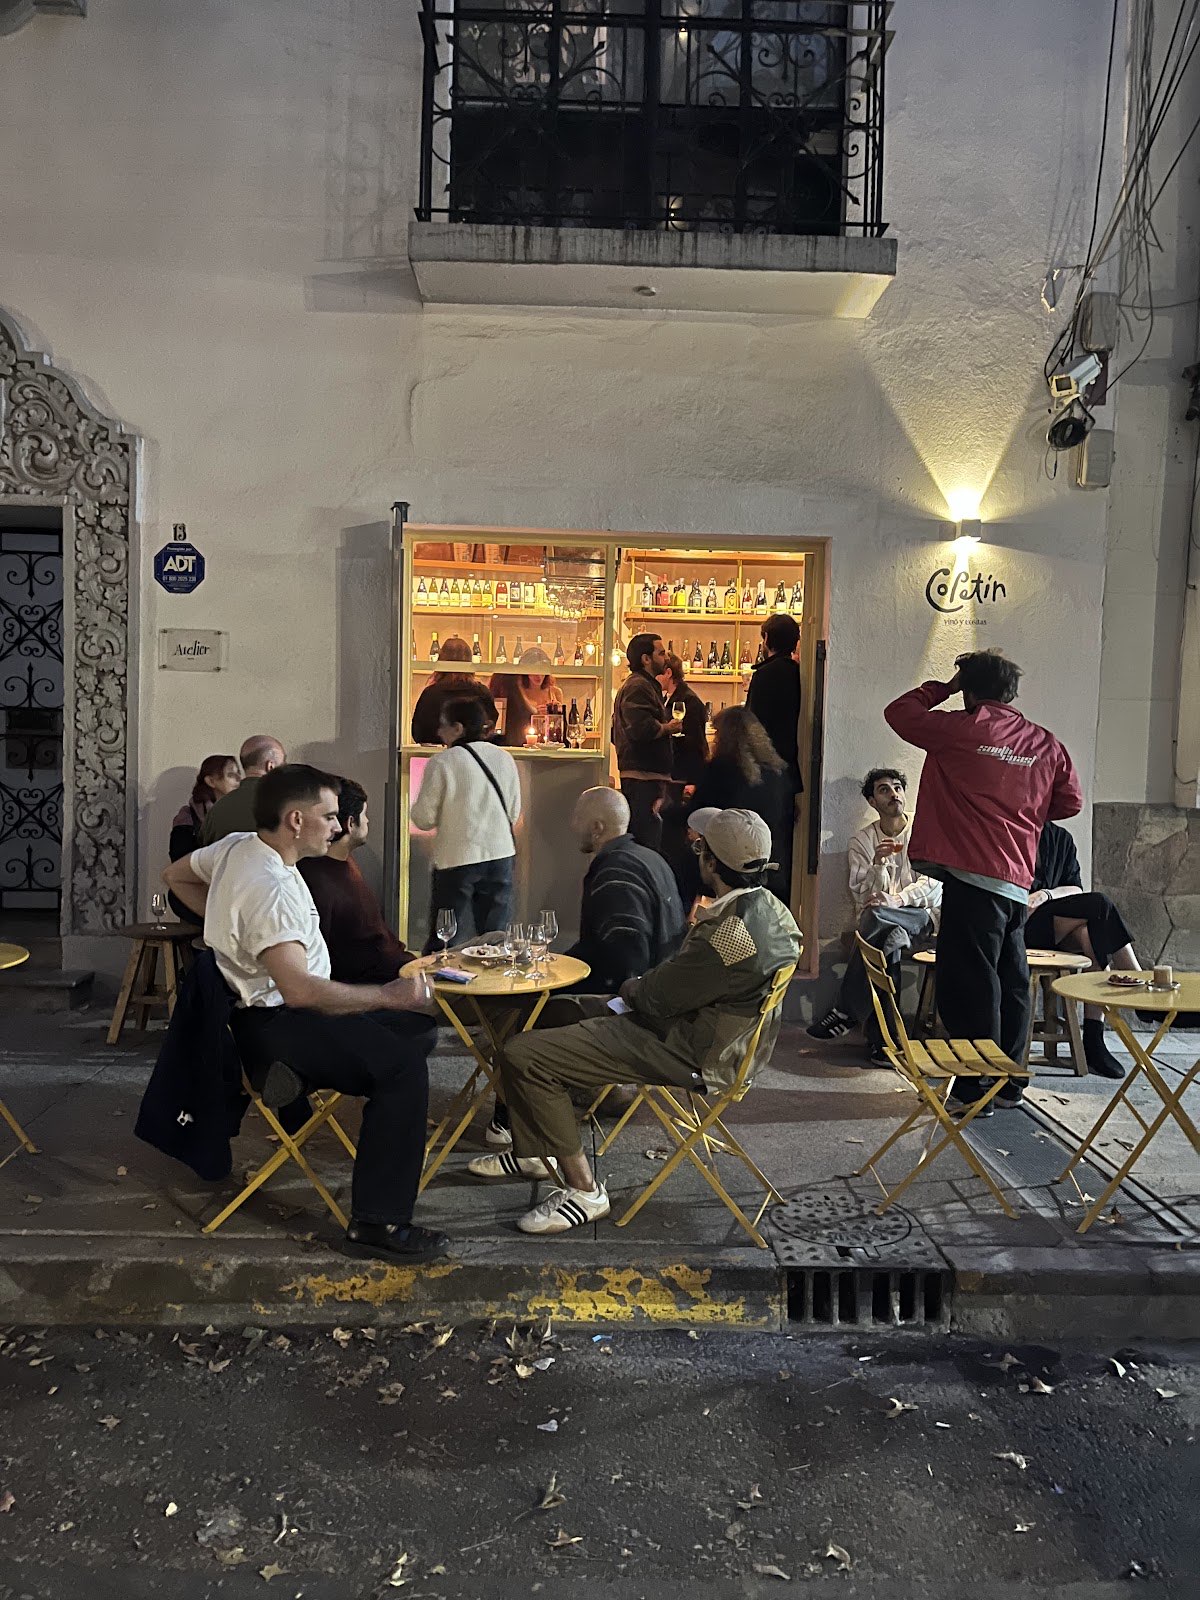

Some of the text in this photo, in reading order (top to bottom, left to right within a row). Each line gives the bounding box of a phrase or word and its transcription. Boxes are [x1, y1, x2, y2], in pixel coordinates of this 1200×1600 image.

[173, 523, 187, 541] 13
[163, 555, 196, 572] ADT
[174, 640, 210, 656] Atelier
